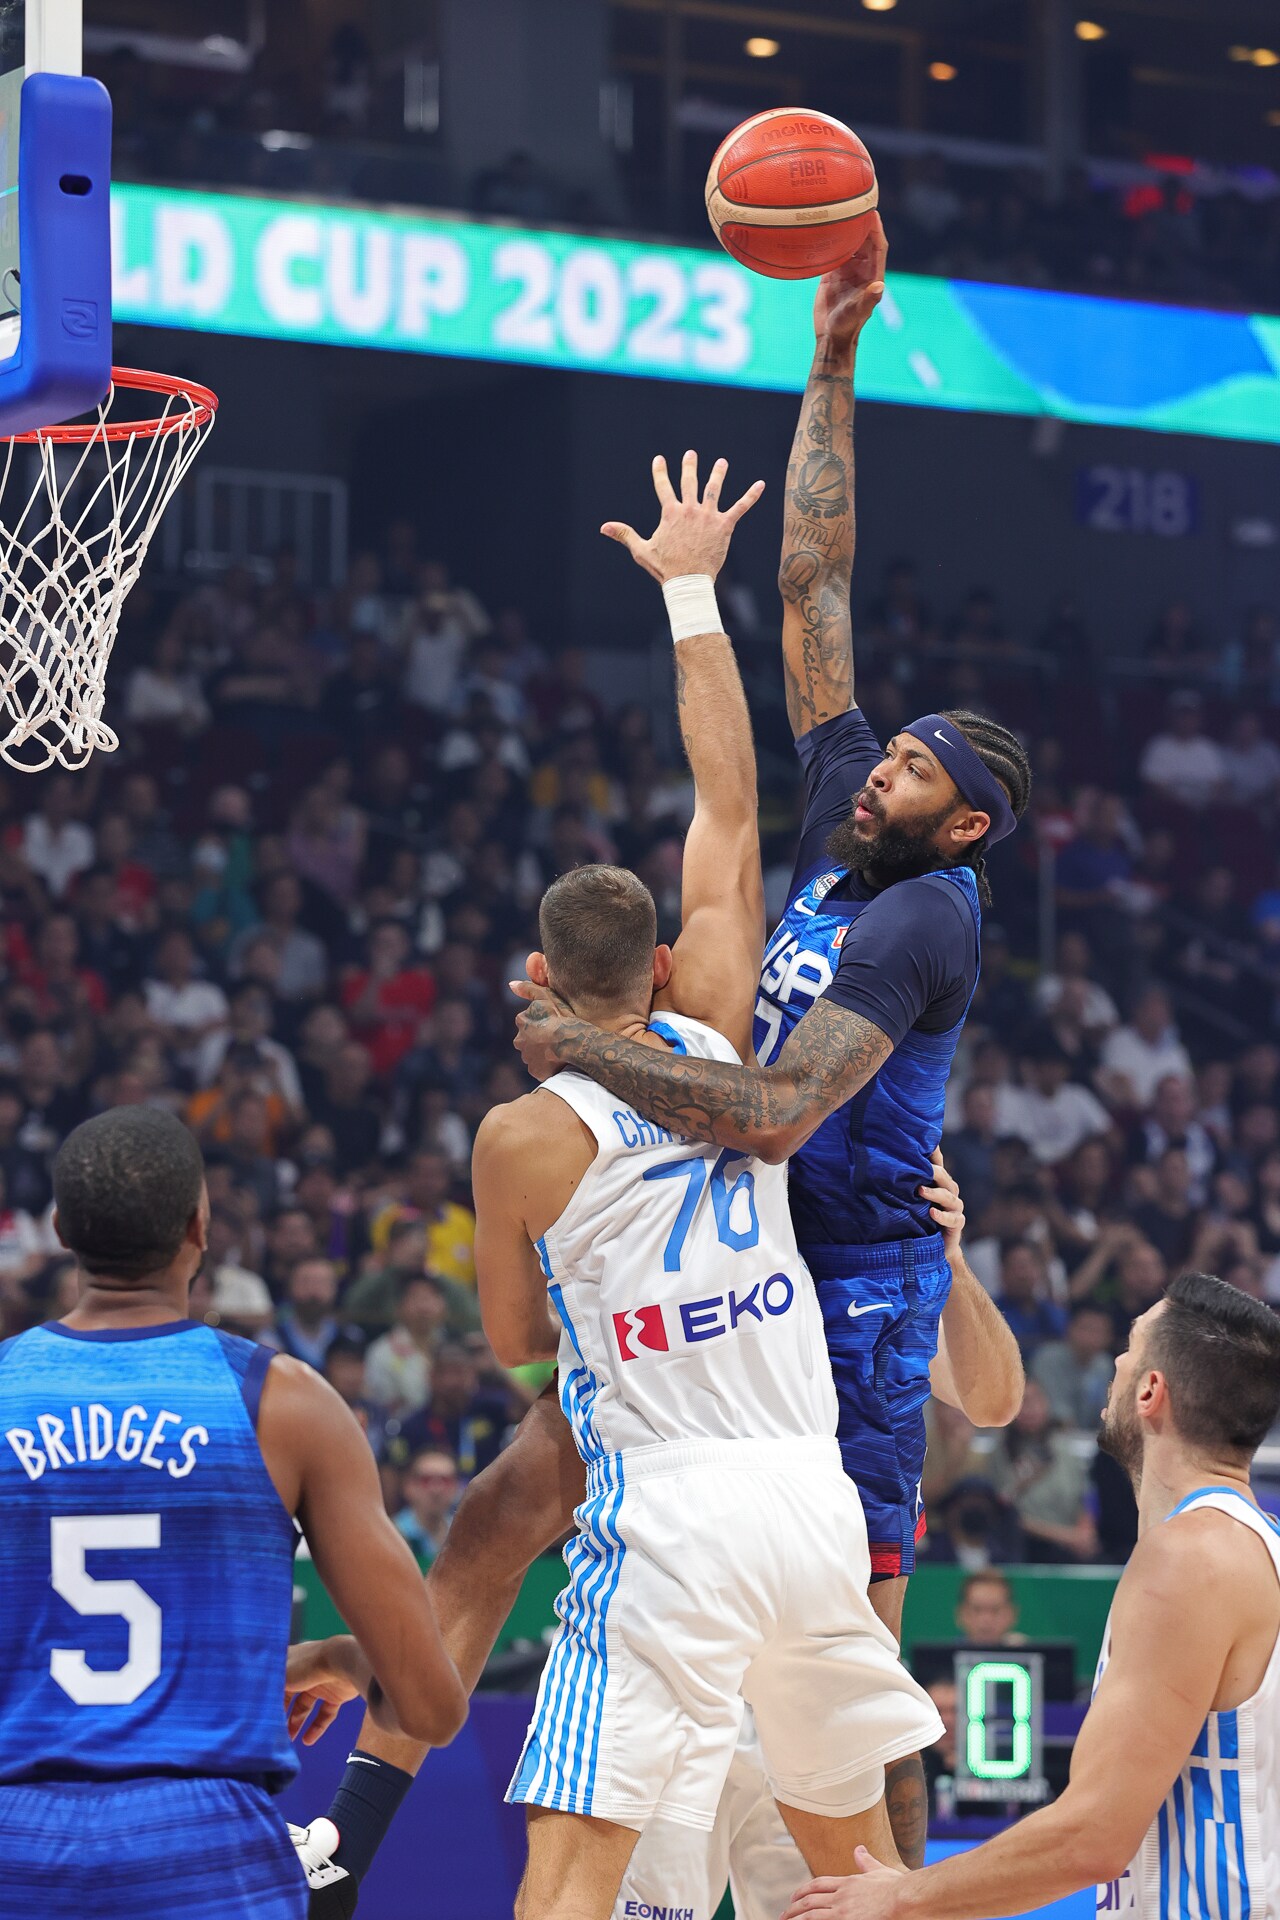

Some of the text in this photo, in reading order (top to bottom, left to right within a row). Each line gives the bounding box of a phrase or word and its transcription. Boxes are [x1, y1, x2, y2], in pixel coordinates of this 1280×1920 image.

[761, 122, 837, 144] molten
[789, 158, 827, 179] FIBA
[255, 212, 473, 338] CUP
[491, 239, 751, 373] 2023
[1088, 466, 1190, 538] 218
[612, 1110, 686, 1149] CHA
[642, 1146, 760, 1273] 76
[678, 1272, 795, 1343] EKO
[5, 1402, 210, 1481] BRIDGES
[50, 1513, 162, 1706] 5
[966, 1661, 1032, 1779] 0
